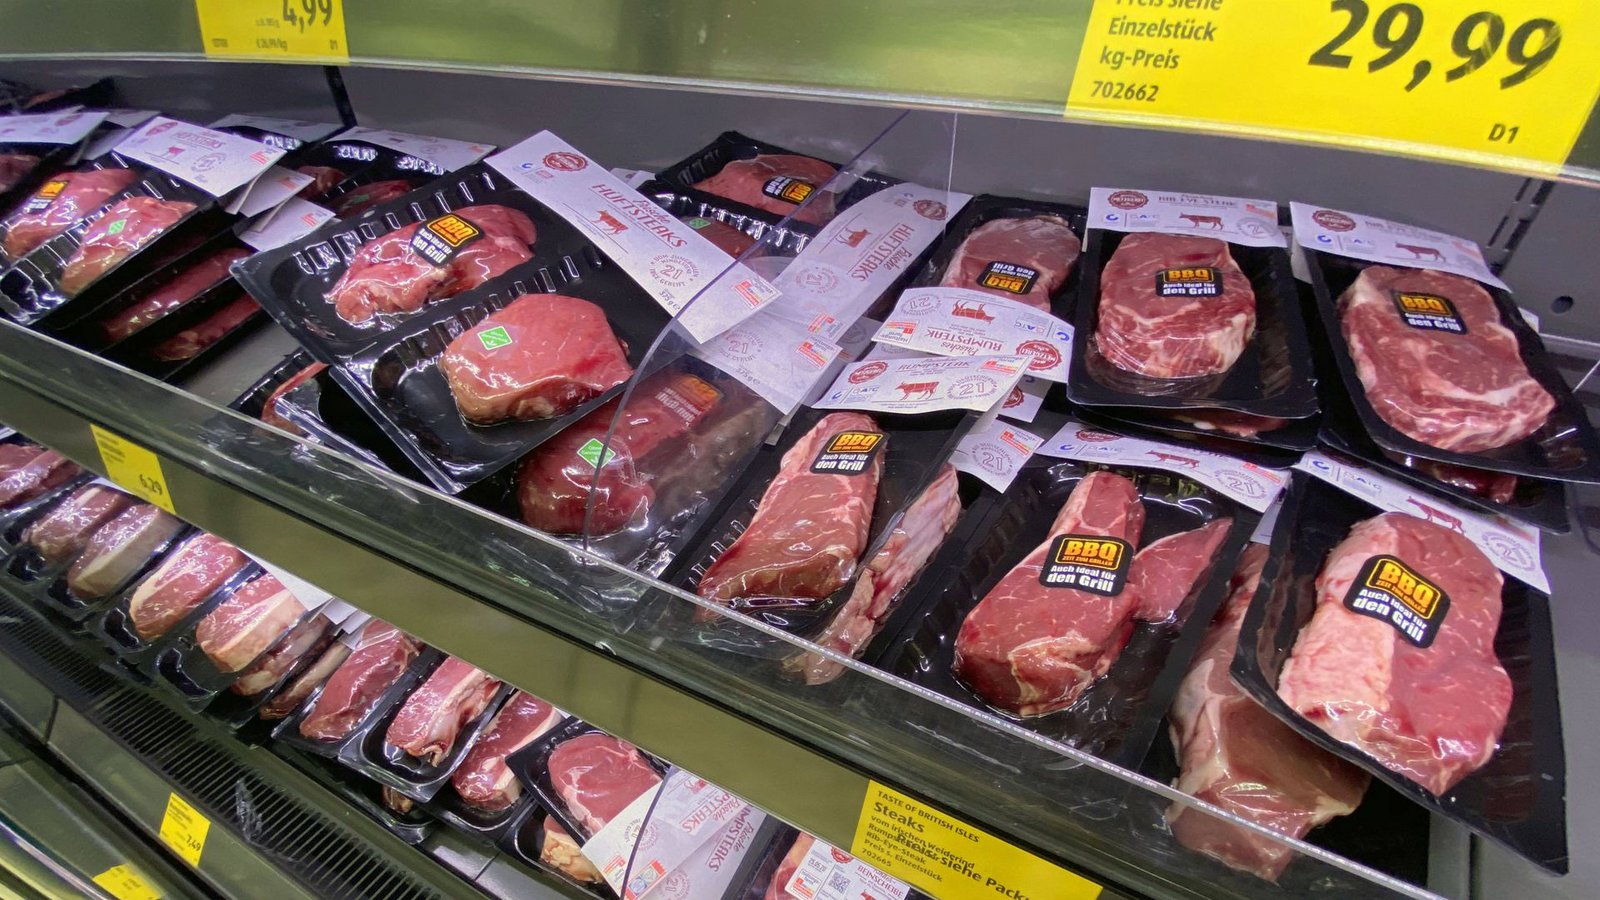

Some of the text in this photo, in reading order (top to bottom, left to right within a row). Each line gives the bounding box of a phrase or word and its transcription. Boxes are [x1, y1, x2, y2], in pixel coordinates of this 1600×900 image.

[282, 0, 333, 33] 4,99
[1108, 15, 1217, 41] Einzelstück
[1308, 0, 1562, 92] 29,99
[1100, 45, 1180, 70] kg-Preis
[1090, 80, 1159, 102] 702662
[1488, 123, 1519, 144] D1
[437, 216, 474, 241] BBQ
[659, 264, 684, 281] 21
[1168, 269, 1209, 279] BBQ
[987, 276, 1022, 291] BBQ
[1163, 287, 1216, 295] den Grill
[1401, 296, 1444, 311] BBQ
[925, 328, 1004, 351] RUMPSTEAK
[835, 434, 878, 446] BBQ
[815, 461, 865, 471] den Grill
[982, 452, 1003, 471] 21
[1065, 541, 1118, 561] BBQ
[1046, 573, 1114, 592] den Grill
[1101, 570, 1117, 580] für
[1379, 562, 1434, 607] BBQ
[1359, 589, 1390, 602] Auch
[1353, 597, 1424, 642] den Grill
[871, 815, 891, 828] vom
[873, 802, 925, 834] Steaks
[878, 790, 980, 843] TASTE OF BRITISH ISLES
[861, 847, 892, 868] 702665
[866, 831, 927, 865] Rib-Eye-Steak
[863, 838, 886, 856] Preis
[894, 853, 943, 883] Einzelstück
[857, 864, 904, 898] BEINSCHEIBE
